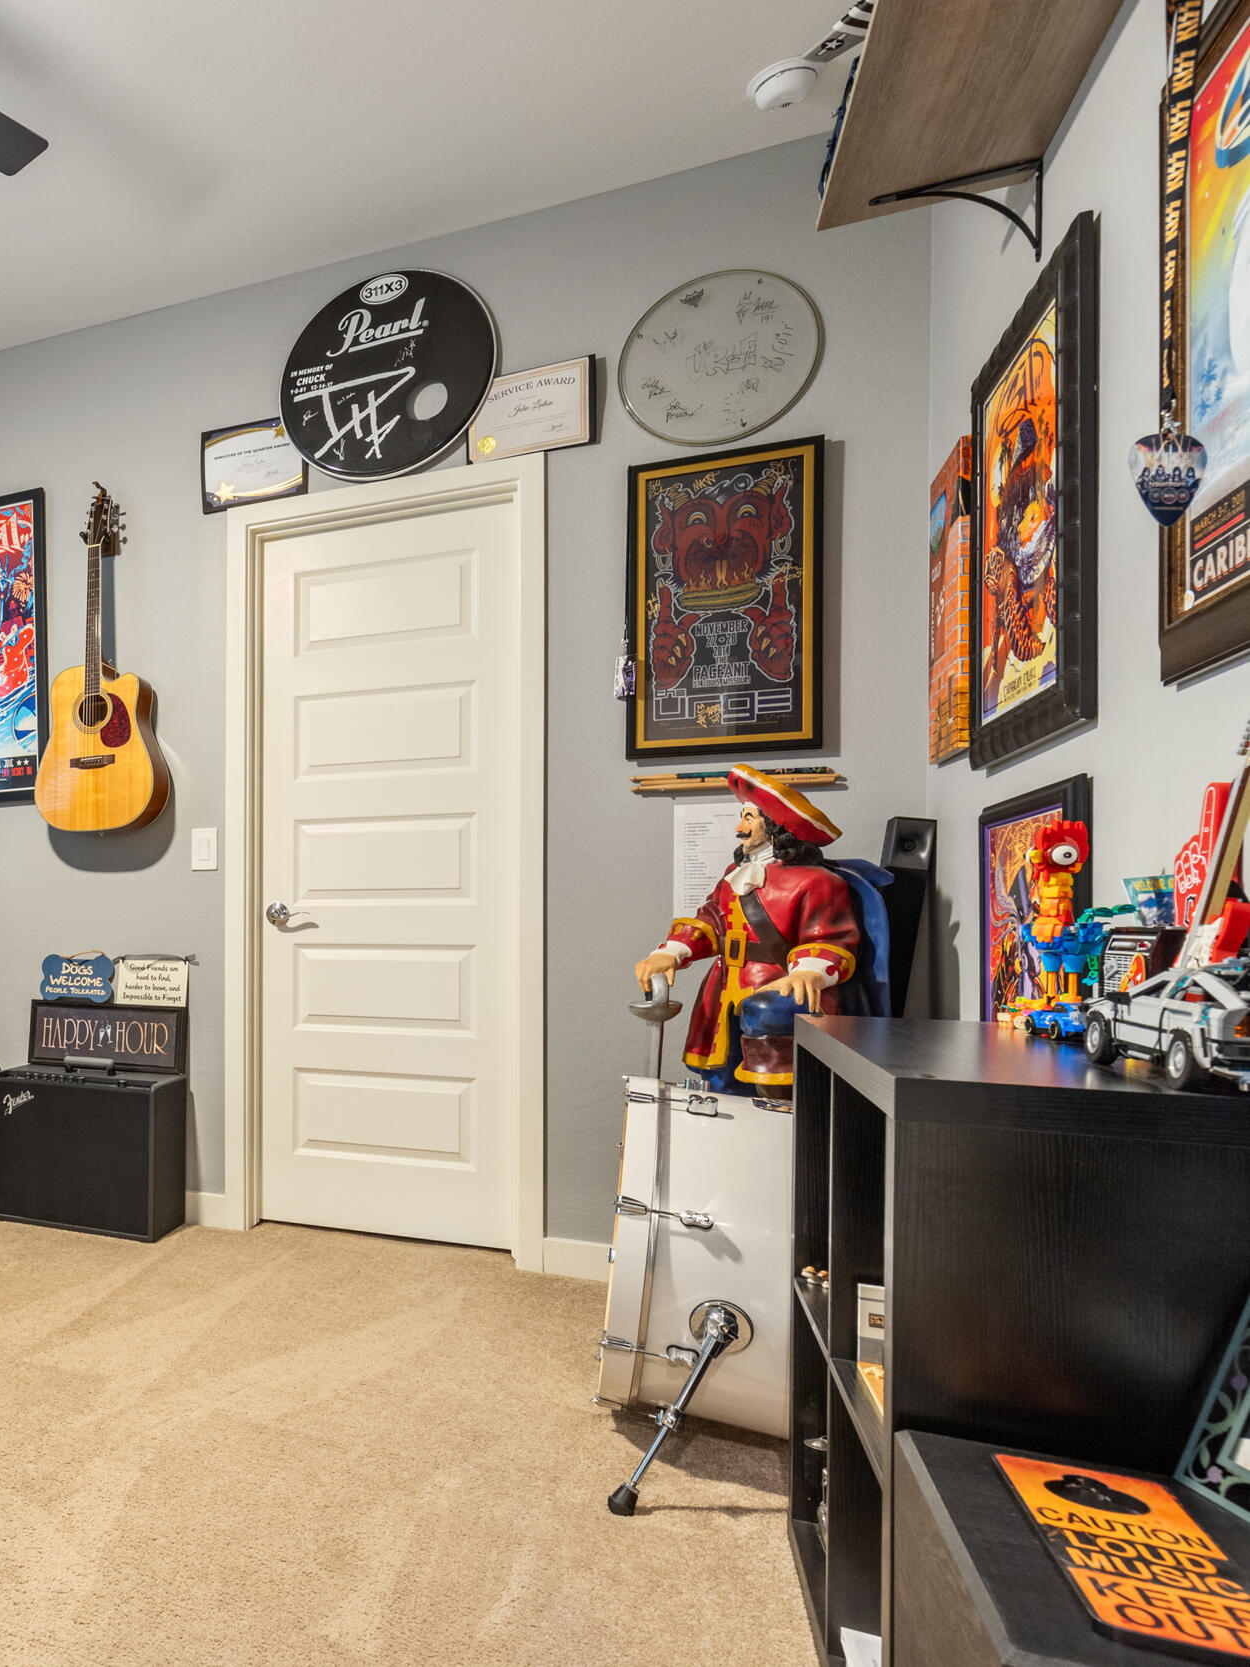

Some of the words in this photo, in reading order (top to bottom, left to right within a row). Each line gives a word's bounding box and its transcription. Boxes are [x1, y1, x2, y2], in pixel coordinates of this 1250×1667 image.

[1171, 49, 1197, 95] KISS
[1168, 99, 1192, 145] KISS
[1166, 149, 1187, 195] KISS
[364, 279, 403, 299] 311X3
[326, 297, 427, 358] Pearl
[290, 370, 298, 378] IN
[298, 365, 324, 376] MEMORY
[324, 363, 334, 371] OF
[296, 373, 326, 387] CHUCK
[487, 381, 534, 404] SERVICE
[536, 376, 576, 388] AWARD
[1193, 529, 1250, 592] CARIB
[695, 620, 749, 636] NOVEMBER
[715, 656, 728, 664] THE
[693, 661, 751, 680] PAGEANT
[61, 962, 94, 976] DOGS
[136, 974, 150, 982] hard
[45, 986, 68, 995] PEOPLE
[69, 987, 106, 996] TOLERATED
[49, 975, 104, 988] WELCOME
[125, 983, 144, 991] harder
[123, 992, 154, 1001] Impossible
[162, 994, 182, 1003] Forget
[41, 1017, 98, 1050] HAPPY
[115, 1021, 169, 1055] HOUR
[1036, 1507, 1213, 1553] CAUTION
[1061, 1529, 1218, 1575] LOUD
[1064, 1546, 1250, 1600] MUSIC
[1114, 1603, 1250, 1649] OUT
